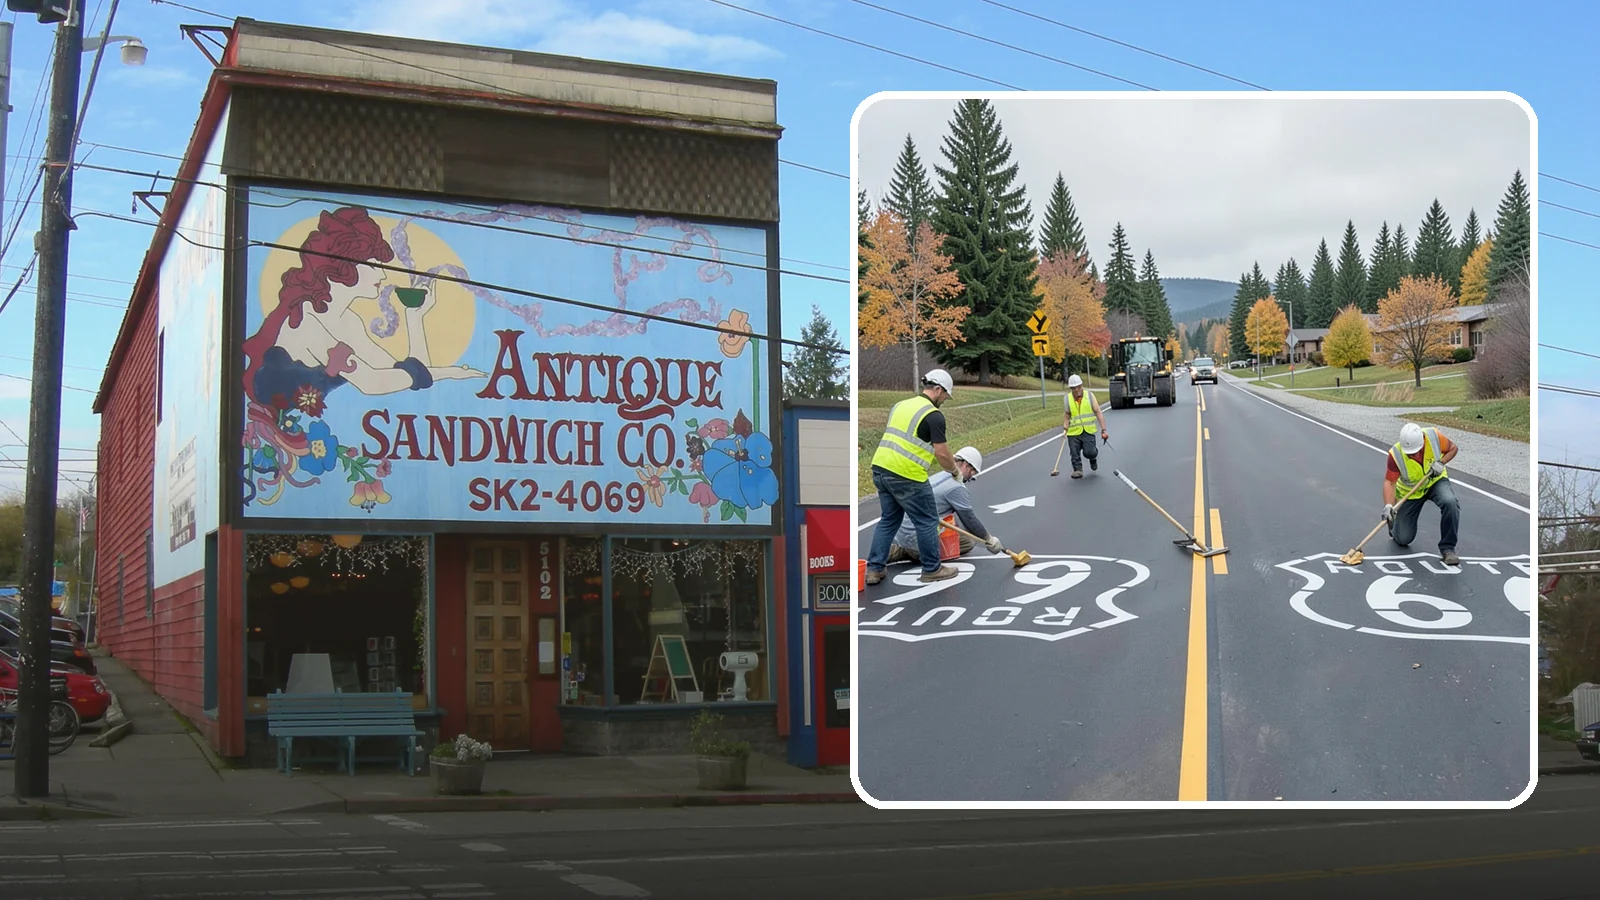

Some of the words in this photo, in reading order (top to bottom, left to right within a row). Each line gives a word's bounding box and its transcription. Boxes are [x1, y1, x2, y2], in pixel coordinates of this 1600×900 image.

[475, 328, 724, 421] ANTIQUE
[361, 408, 604, 468] SANDWICH
[617, 421, 685, 469] CO.
[468, 477, 645, 513] SK2-4069
[539, 541, 552, 599] 5102
[809, 555, 835, 569] BOOKS
[858, 605, 1082, 627] ROUT
